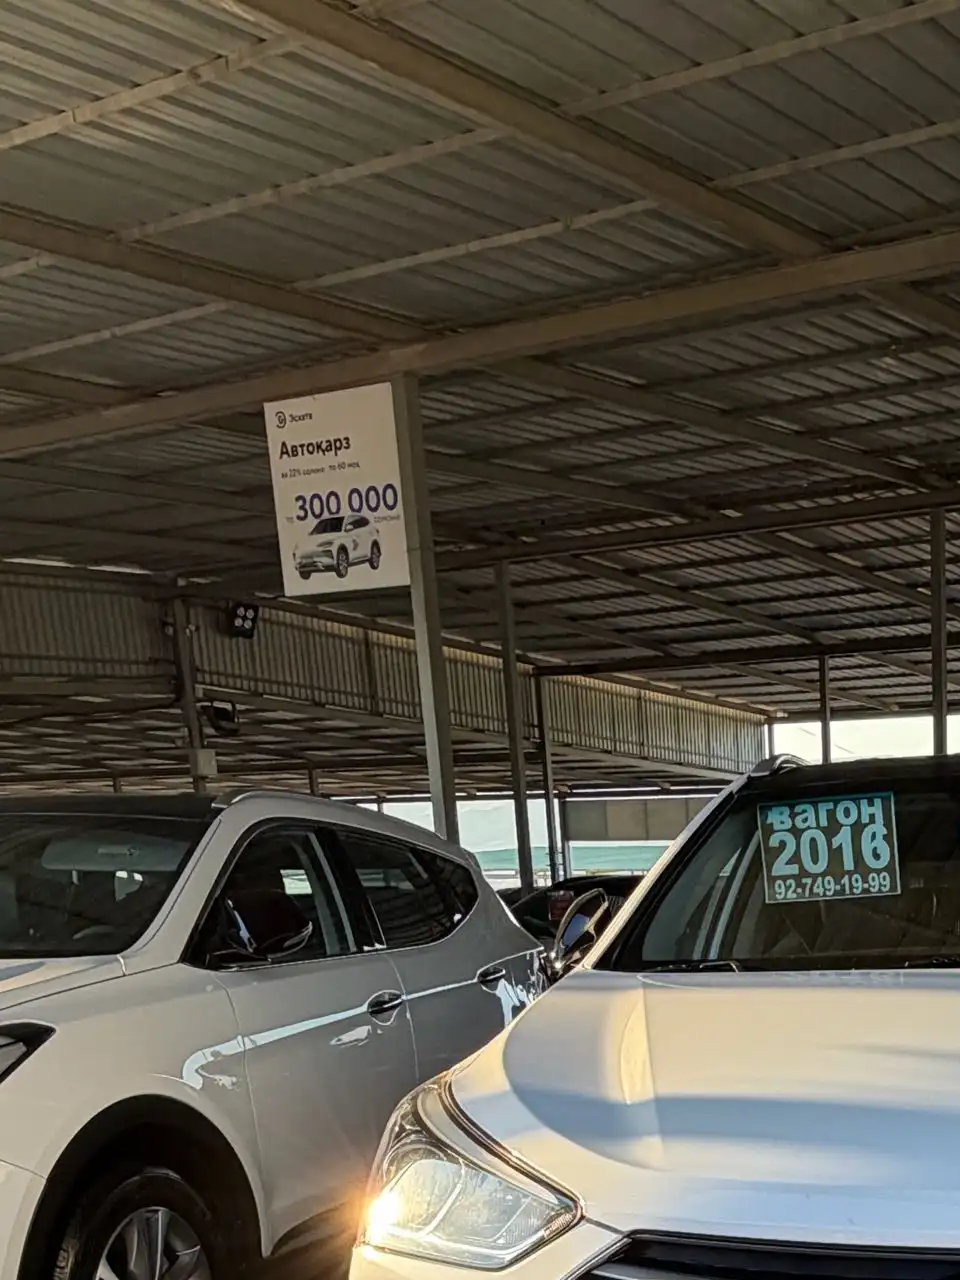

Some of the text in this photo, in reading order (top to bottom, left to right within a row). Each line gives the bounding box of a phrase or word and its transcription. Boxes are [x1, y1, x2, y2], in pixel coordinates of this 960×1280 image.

[279, 436, 352, 460] Автоқарз
[294, 490, 342, 522] 300
[347, 483, 399, 514] 000
[768, 797, 884, 831] вагон
[769, 824, 890, 877] 2016
[774, 871, 891, 899] 92-749-19-99
